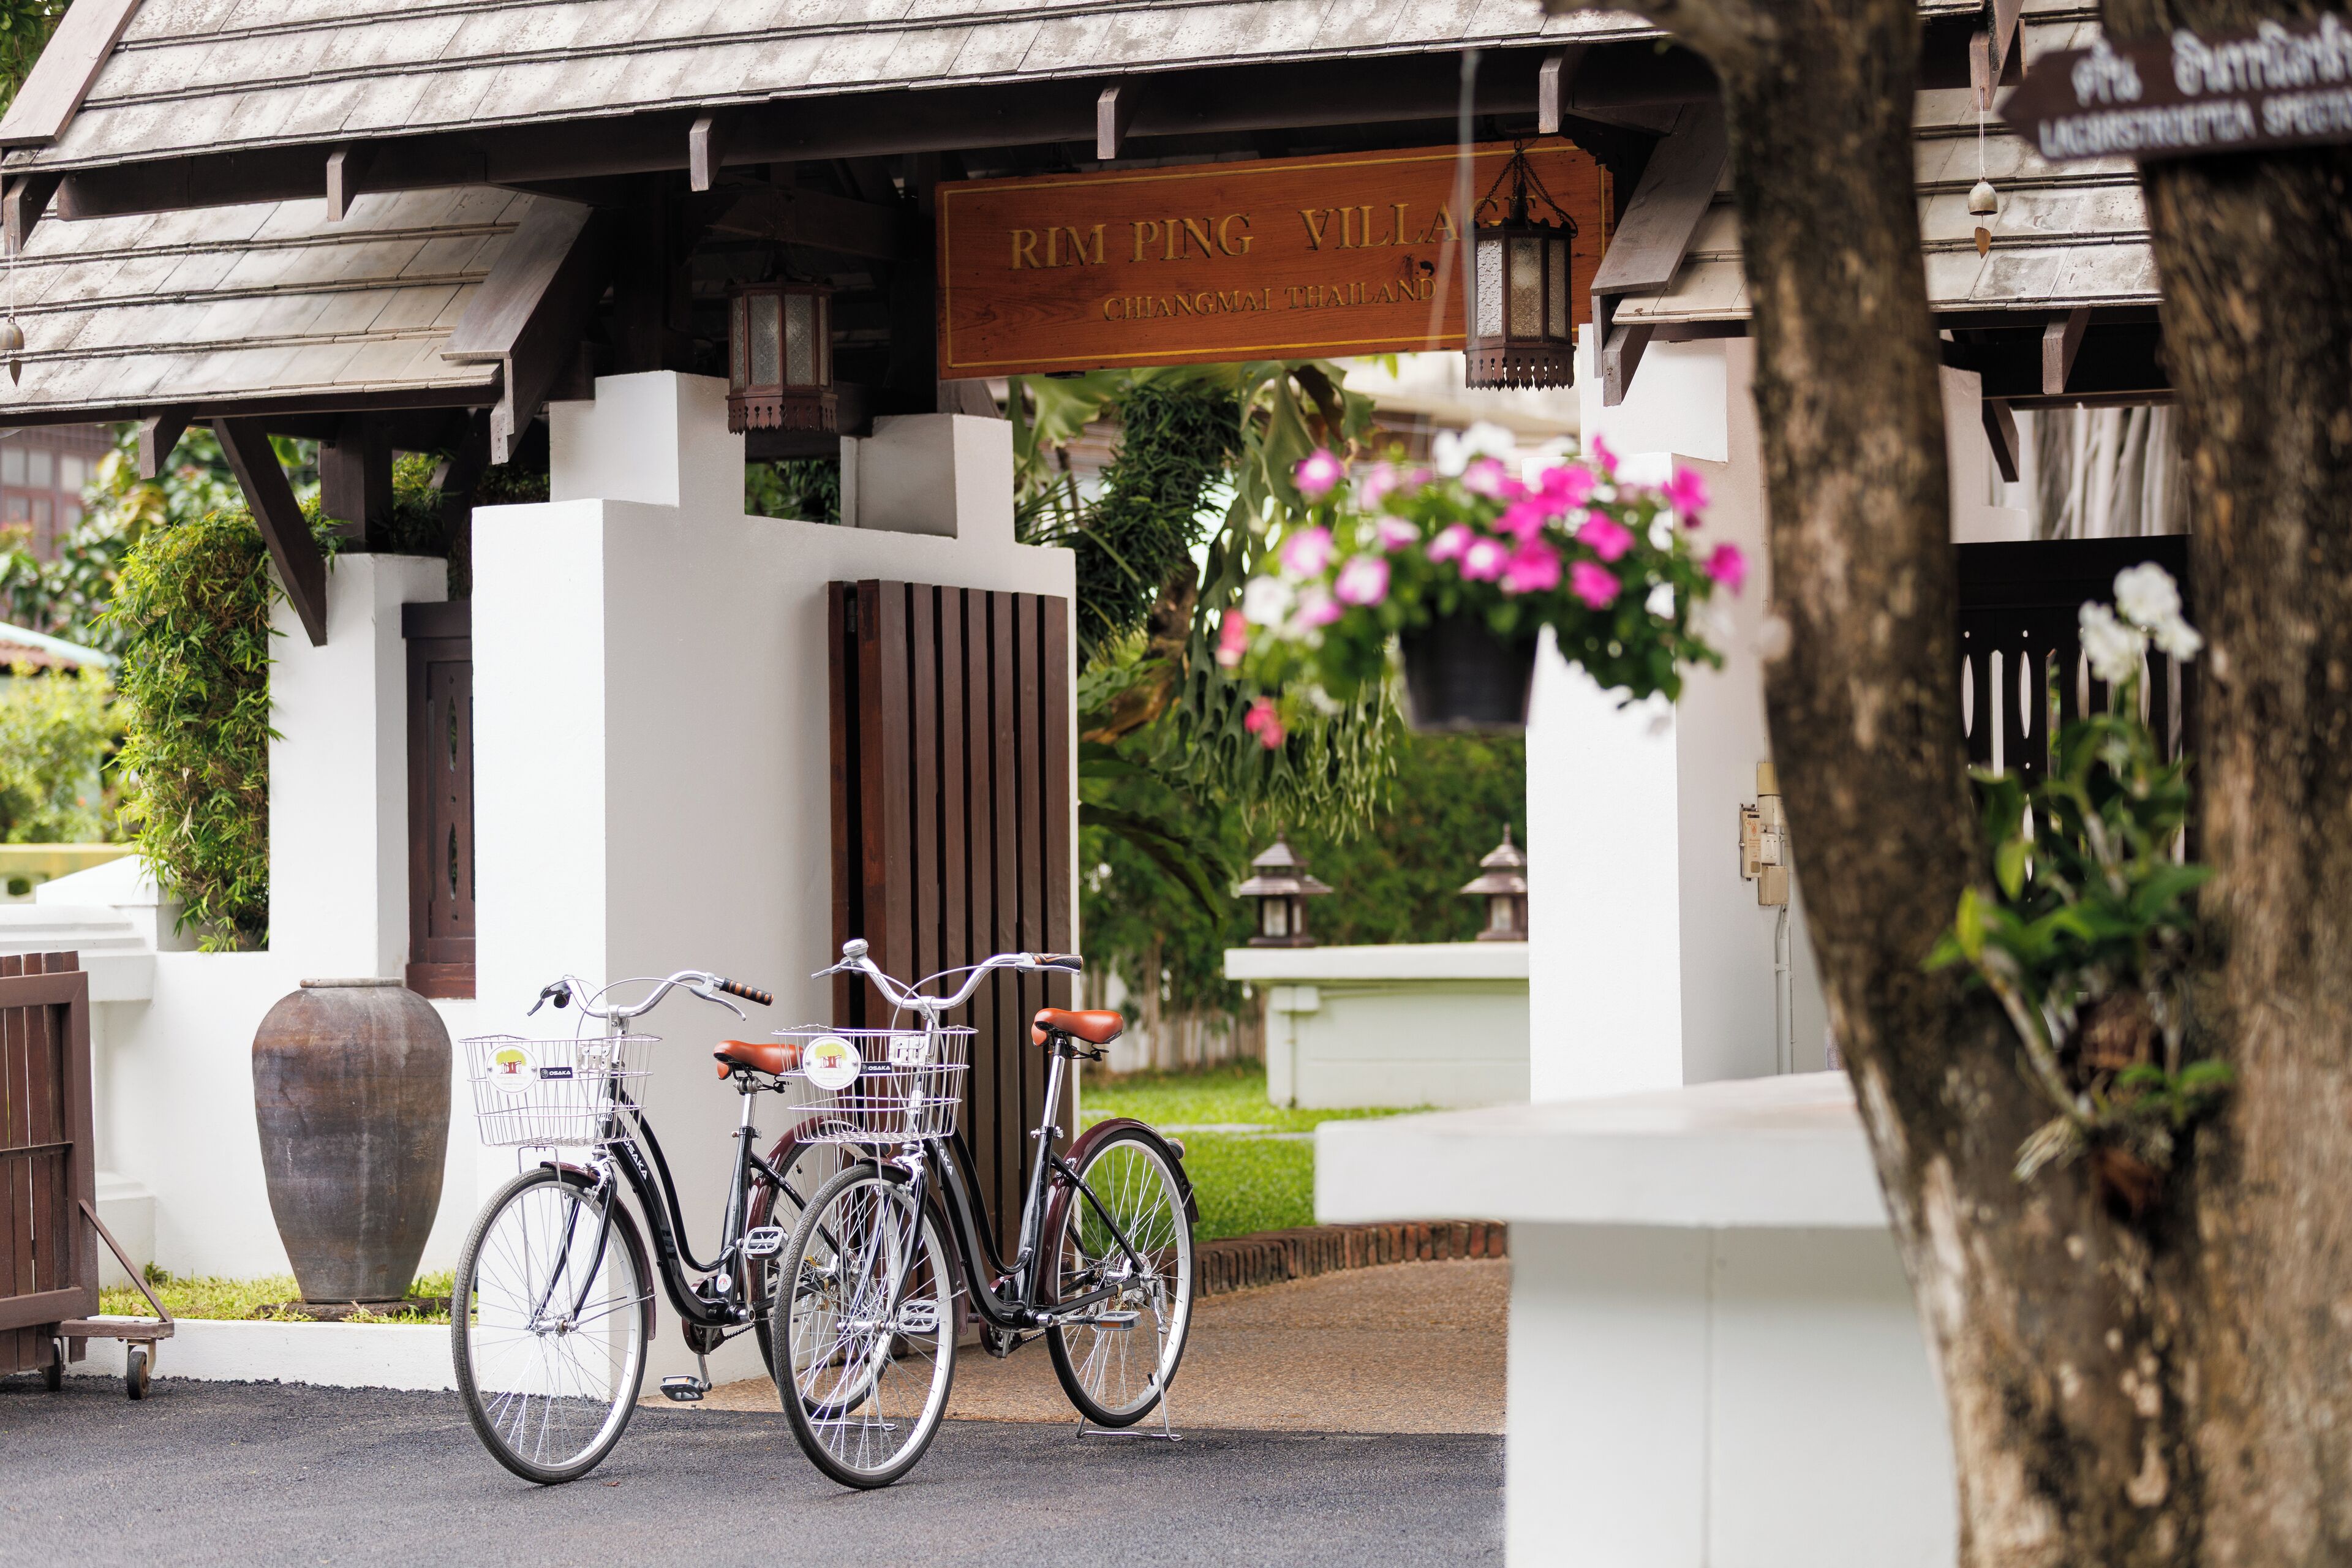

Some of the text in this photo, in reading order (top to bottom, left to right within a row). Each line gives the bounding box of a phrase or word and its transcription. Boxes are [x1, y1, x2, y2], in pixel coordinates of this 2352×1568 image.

[1007, 223, 1107, 271] RIM
[1129, 213, 1254, 263] PING
[1103, 278, 1438, 321] CHIANGMAI THAILAND
